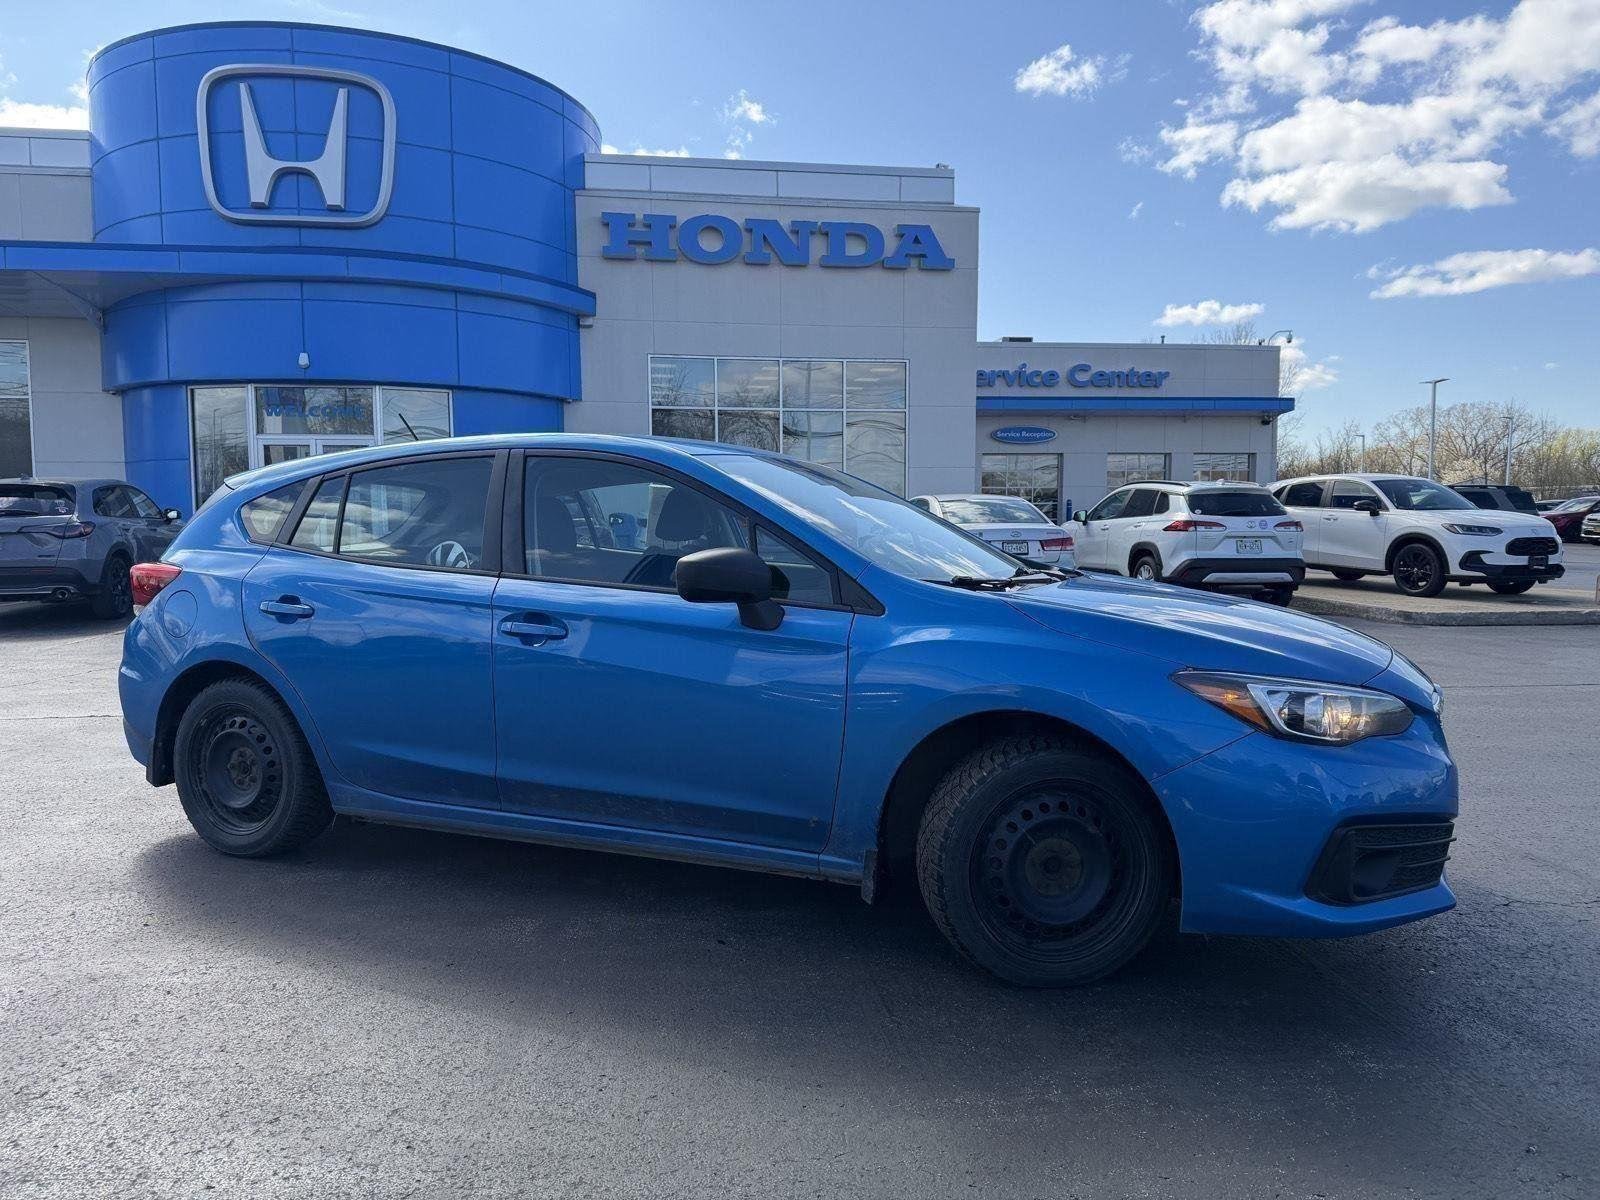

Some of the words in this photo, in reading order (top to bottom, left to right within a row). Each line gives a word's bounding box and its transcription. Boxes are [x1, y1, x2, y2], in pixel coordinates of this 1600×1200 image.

[601, 211, 956, 271] HONDA
[976, 363, 1060, 388] ervice
[1067, 363, 1170, 388] Center
[996, 430, 1020, 438] Service
[1021, 430, 1054, 439] Reception
